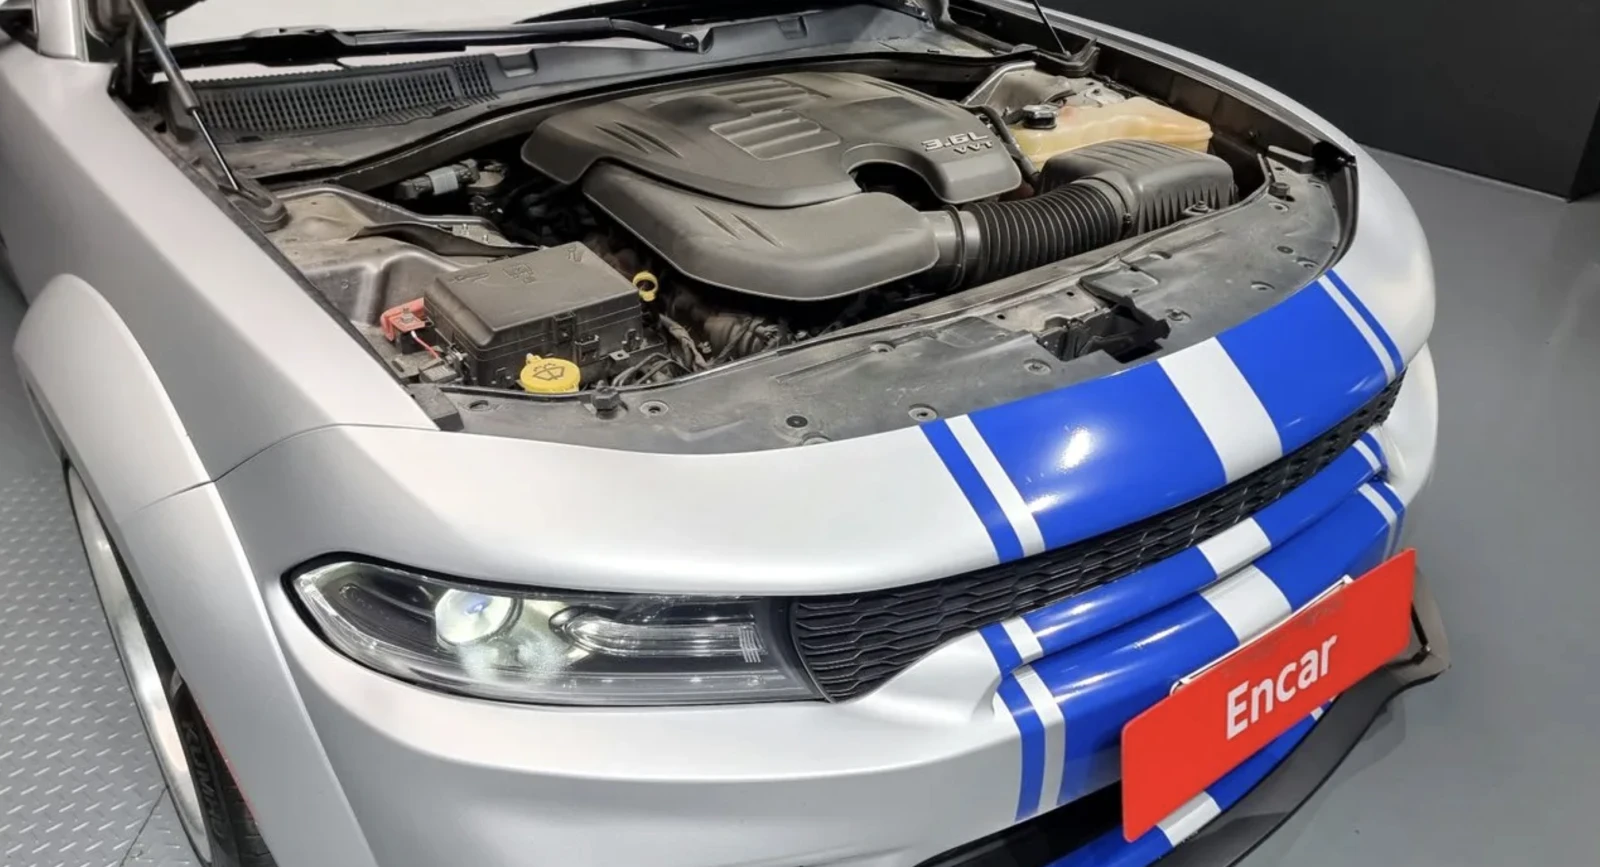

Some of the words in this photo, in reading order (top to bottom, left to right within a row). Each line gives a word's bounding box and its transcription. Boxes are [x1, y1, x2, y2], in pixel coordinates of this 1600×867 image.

[921, 132, 988, 152] 3.6L
[953, 141, 993, 154] VVT
[1226, 634, 1338, 740] Encar
